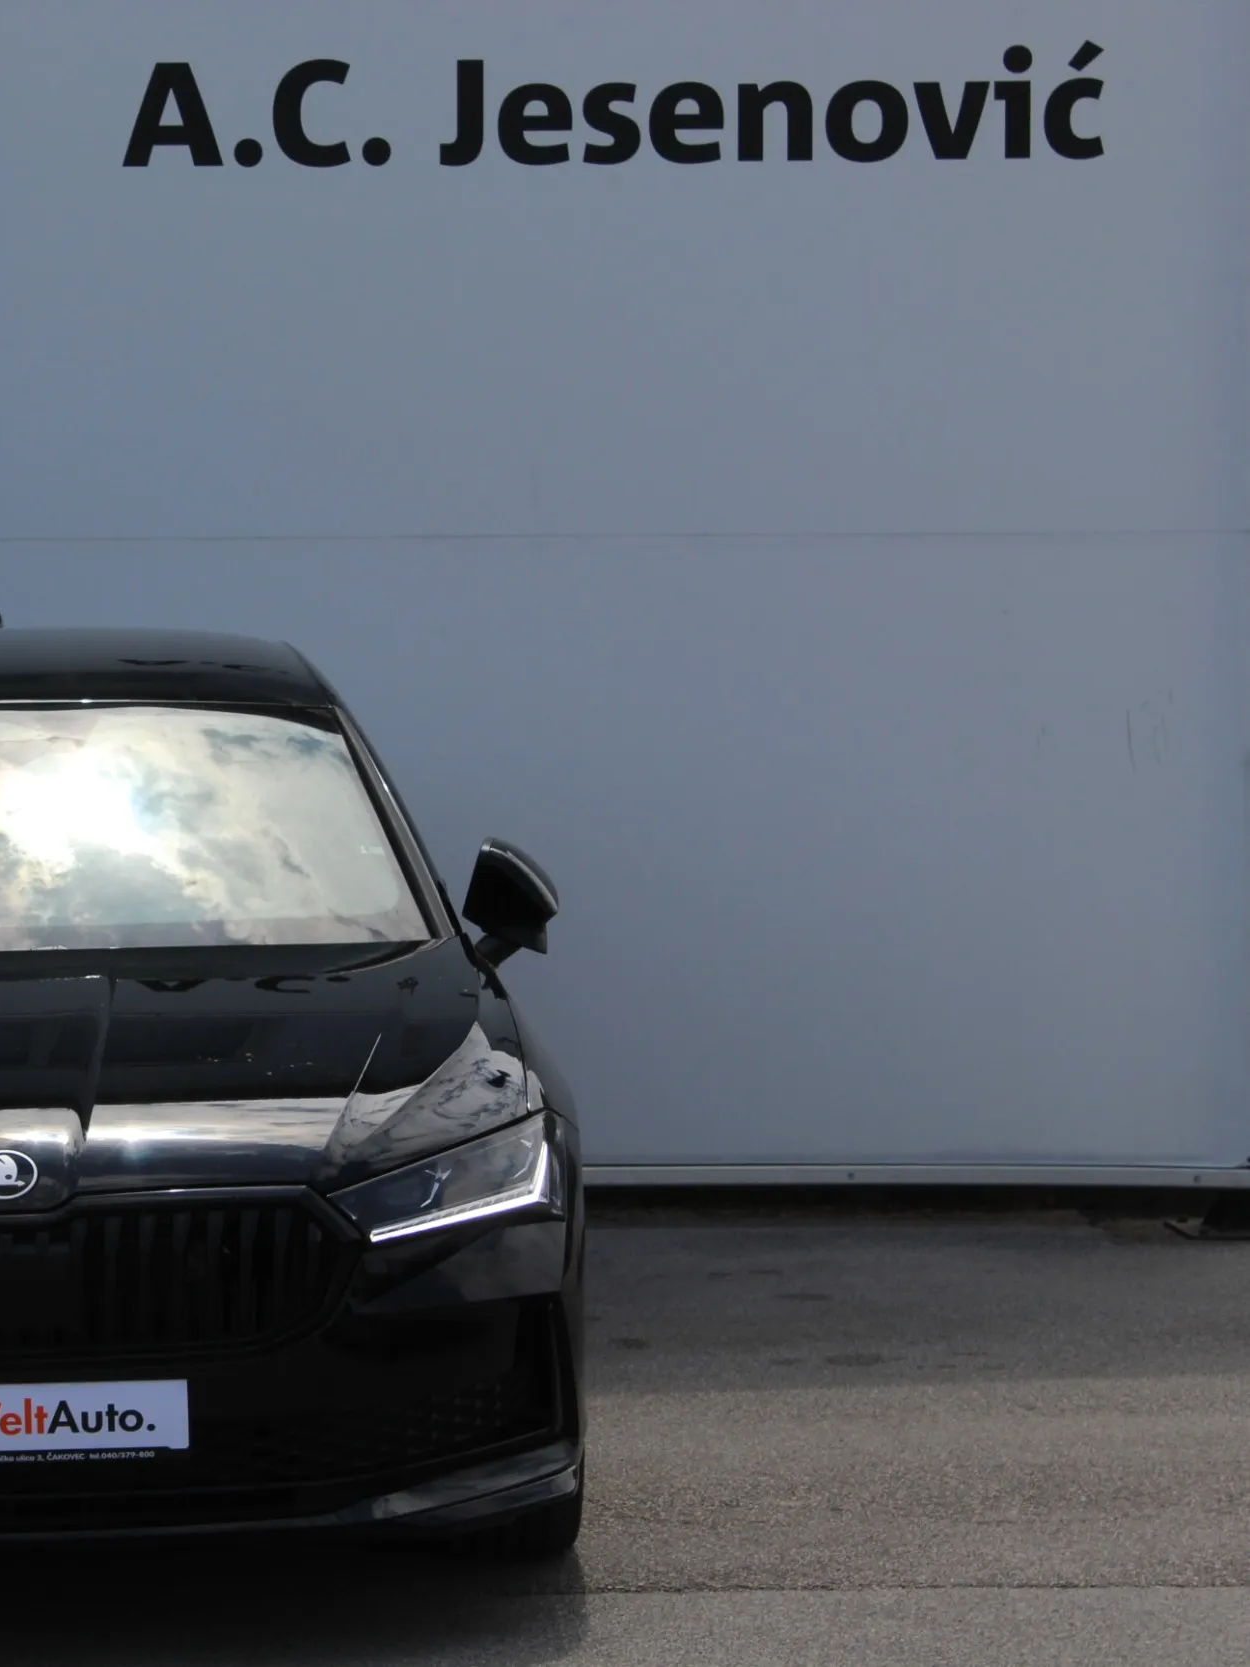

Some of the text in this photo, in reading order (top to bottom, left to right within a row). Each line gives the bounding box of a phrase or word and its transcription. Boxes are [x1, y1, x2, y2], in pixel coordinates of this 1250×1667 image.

[122, 39, 1105, 168] A.C. Jesenović
[46, 1452, 86, 1462] ČAKOVEC
